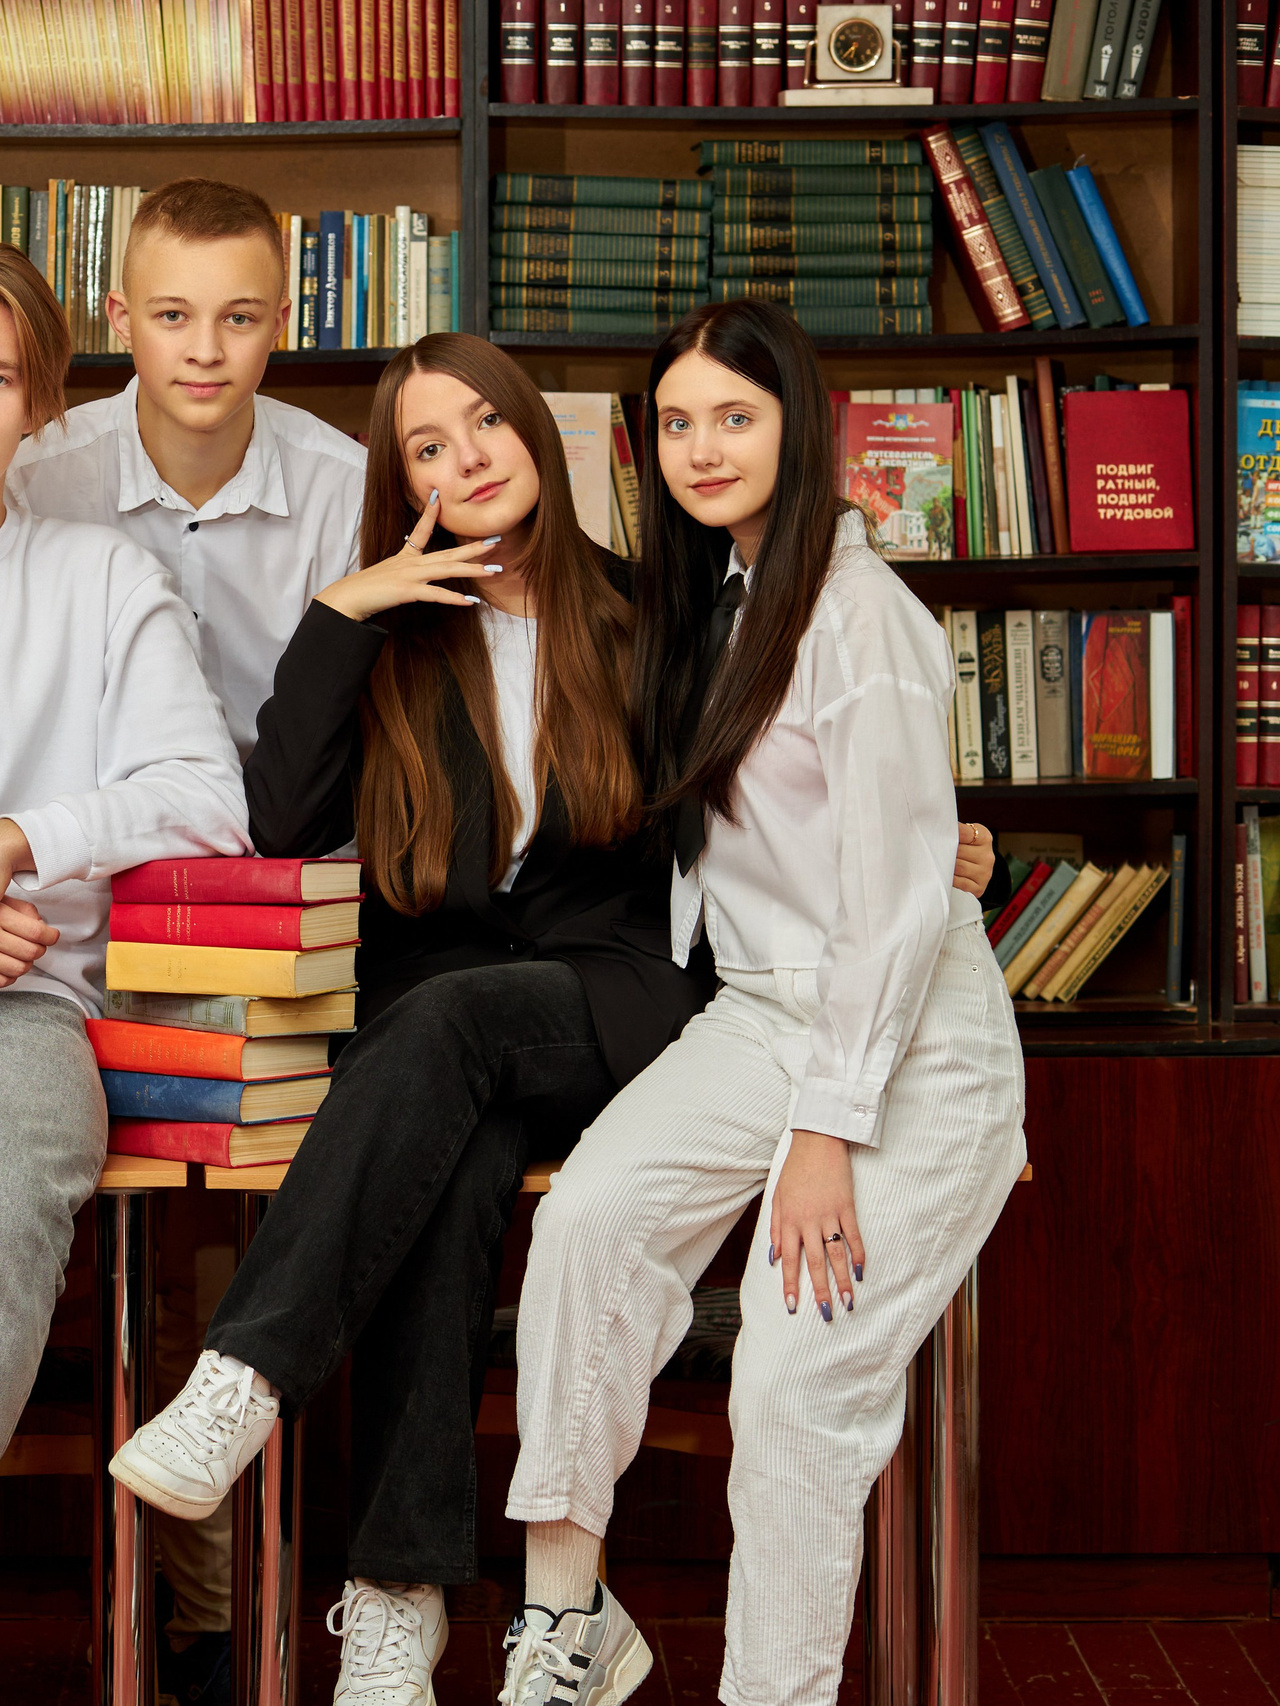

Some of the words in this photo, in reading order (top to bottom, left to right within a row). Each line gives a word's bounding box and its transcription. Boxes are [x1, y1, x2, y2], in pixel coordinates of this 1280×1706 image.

[325, 291, 336, 328] Виктор
[1096, 464, 1154, 476] ПОДВИГ
[1096, 478, 1160, 491] РАТНЫЙ,
[1097, 493, 1155, 505] ПОДВИГ
[1098, 506, 1174, 520] ТРУДОВОЙ
[1235, 863, 1243, 893] МУЗЕЯ
[1235, 895, 1244, 929] ЖИЗНЬ
